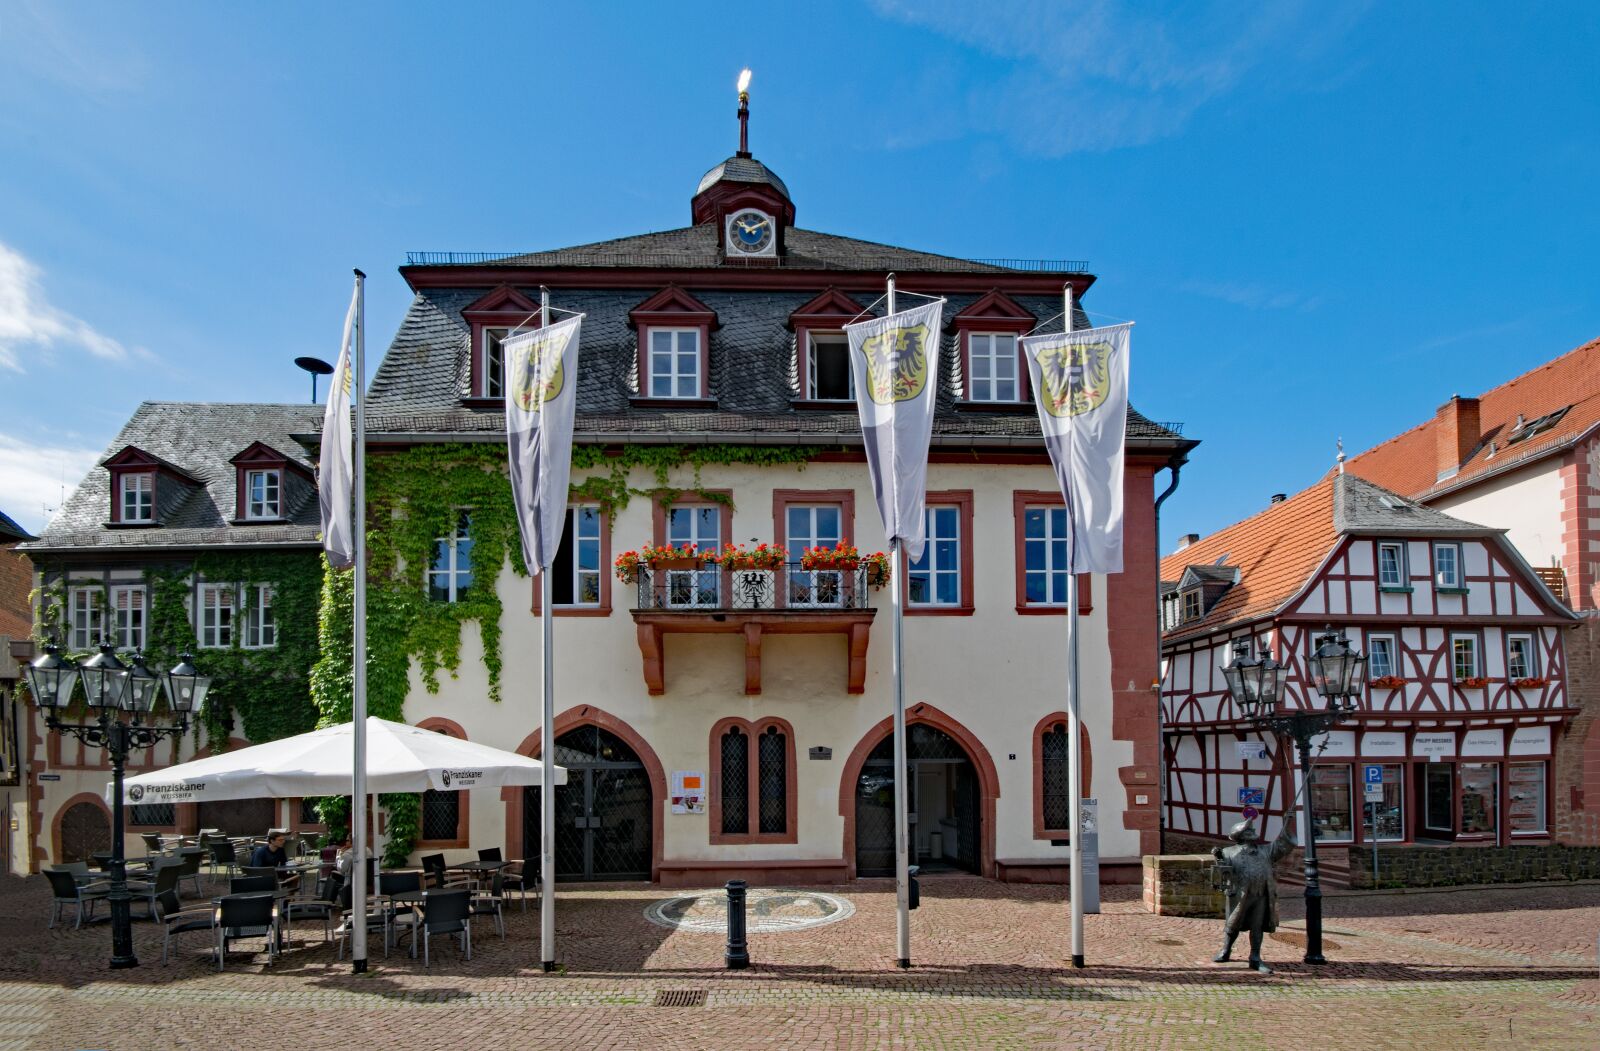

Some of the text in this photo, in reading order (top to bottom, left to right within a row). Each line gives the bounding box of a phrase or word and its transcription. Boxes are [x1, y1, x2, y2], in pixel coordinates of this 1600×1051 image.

[450, 770, 483, 779] Franziskaner
[1369, 767, 1379, 782] P
[146, 783, 206, 793] Franziskaner
